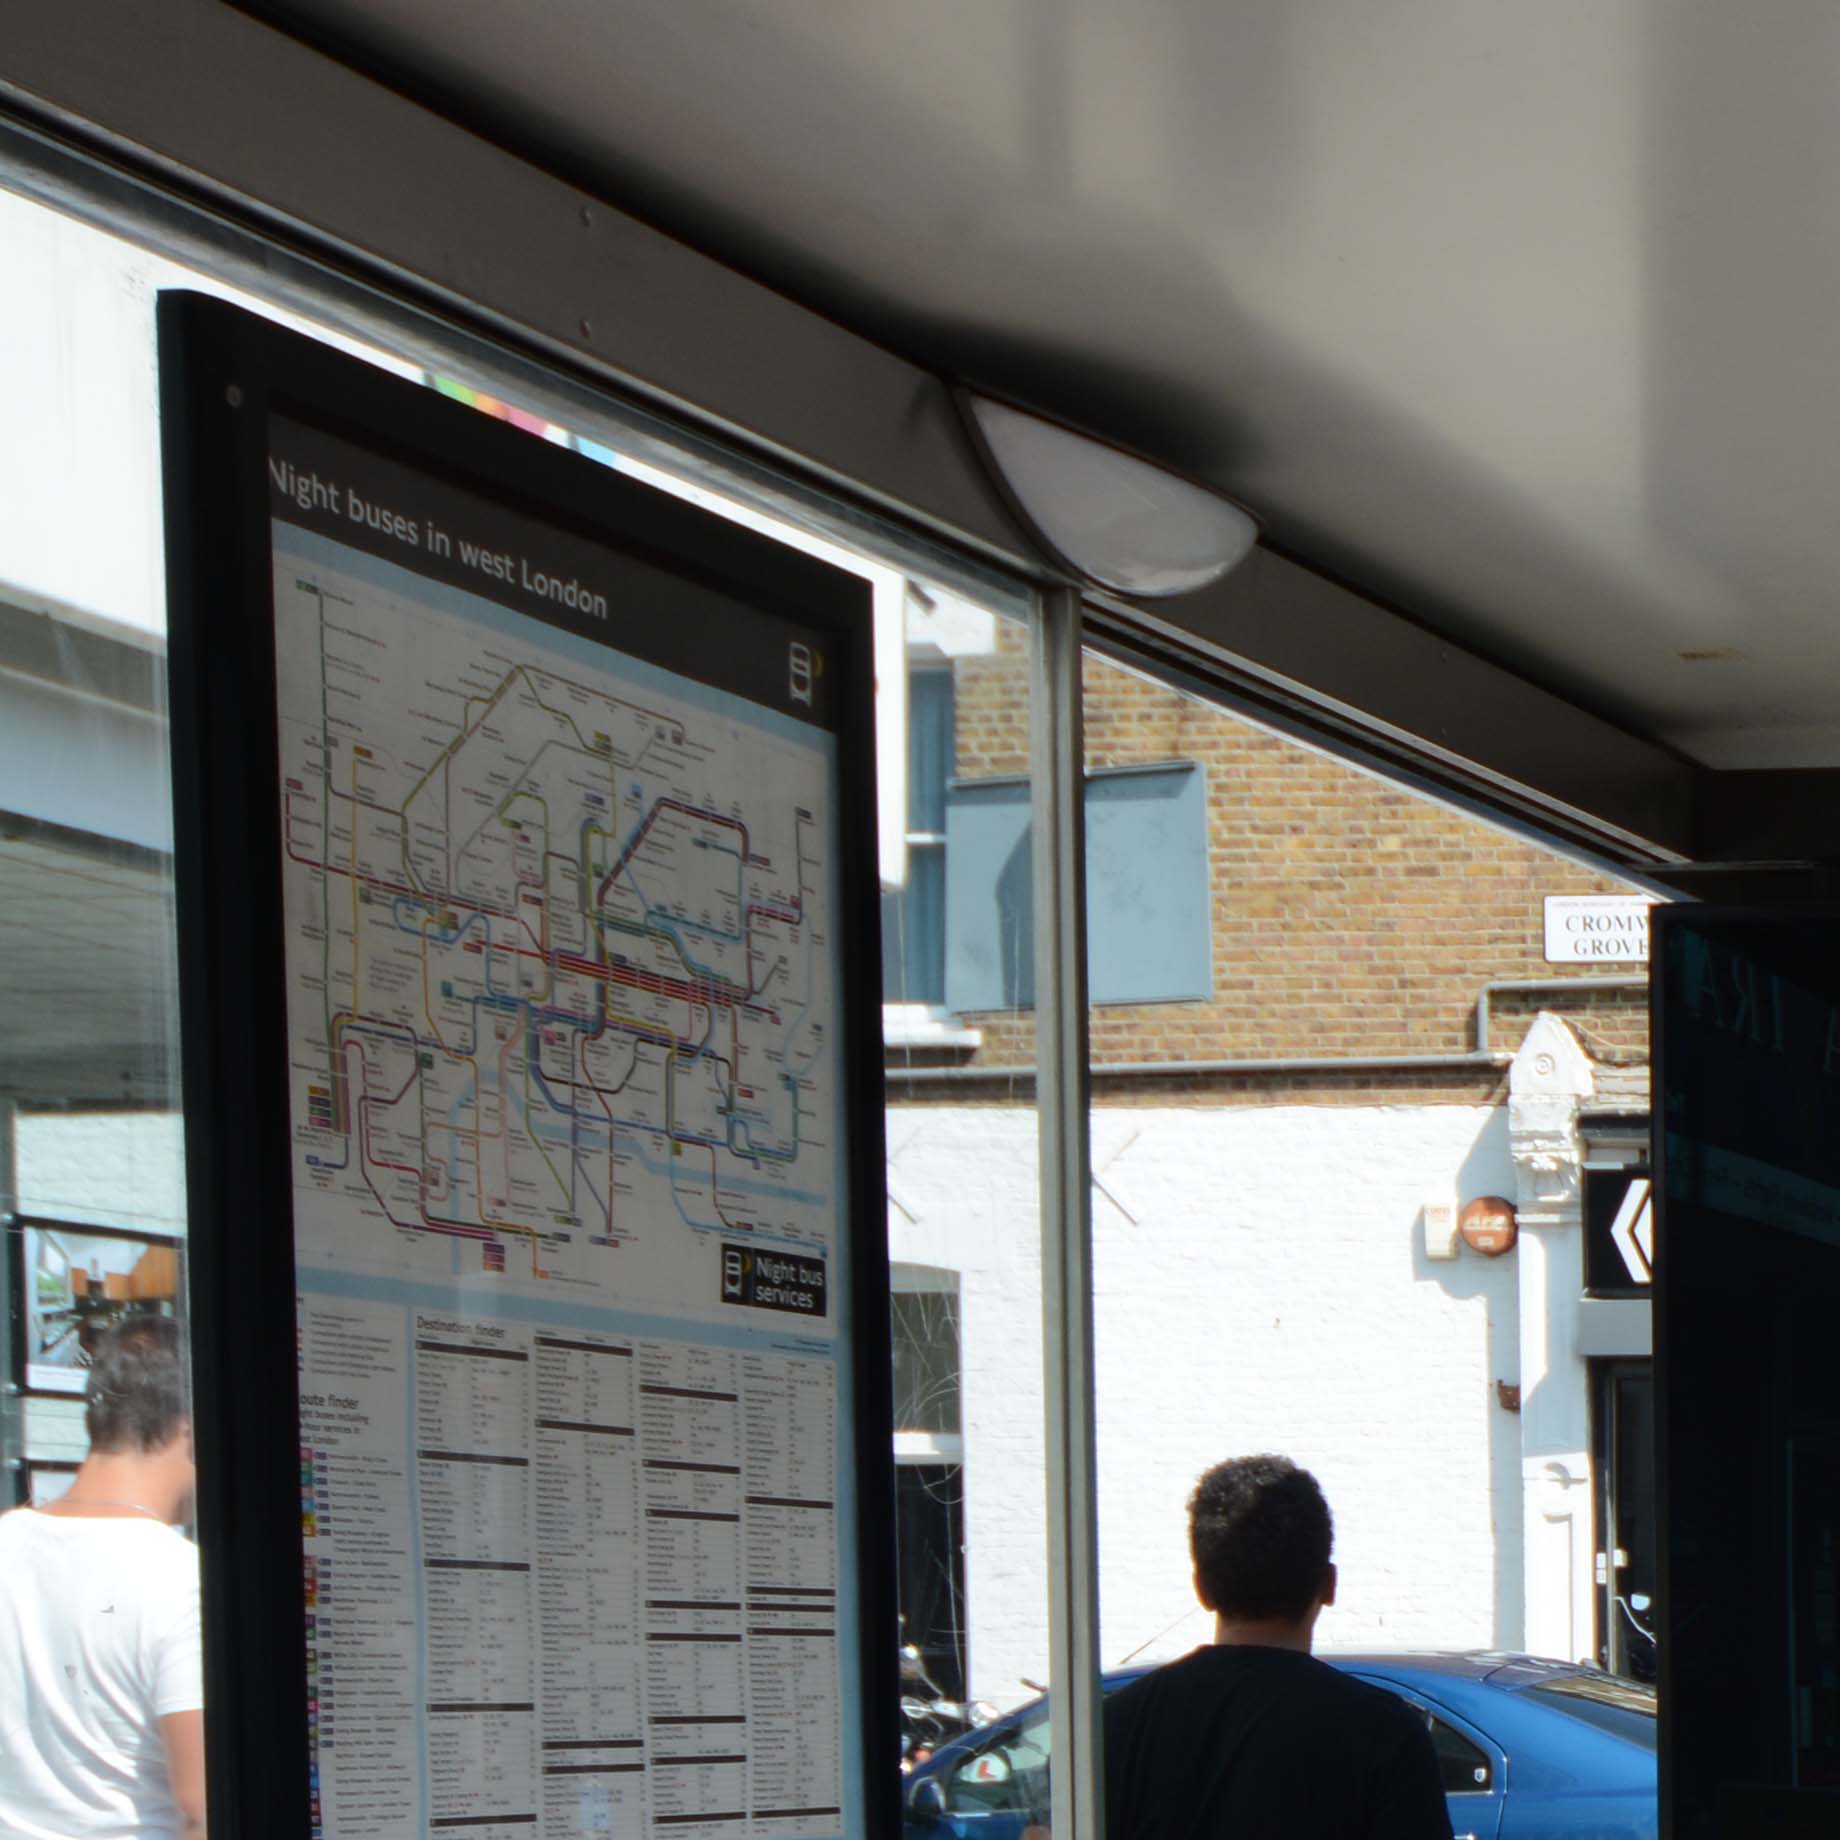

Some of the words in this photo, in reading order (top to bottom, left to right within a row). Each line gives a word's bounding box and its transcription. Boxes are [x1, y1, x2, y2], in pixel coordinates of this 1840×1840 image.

[268, 456, 341, 514] Night
[348, 488, 419, 547] buses
[428, 521, 450, 558] in
[458, 539, 516, 585] west
[521, 559, 608, 621] London
[756, 1256, 797, 1284] Night
[799, 1264, 824, 1287] bus
[755, 1285, 815, 1309] services
[416, 1314, 473, 1334] Destination
[475, 1322, 505, 1339] finder
[300, 1393, 324, 1407] oute
[328, 1393, 360, 1410] finder
